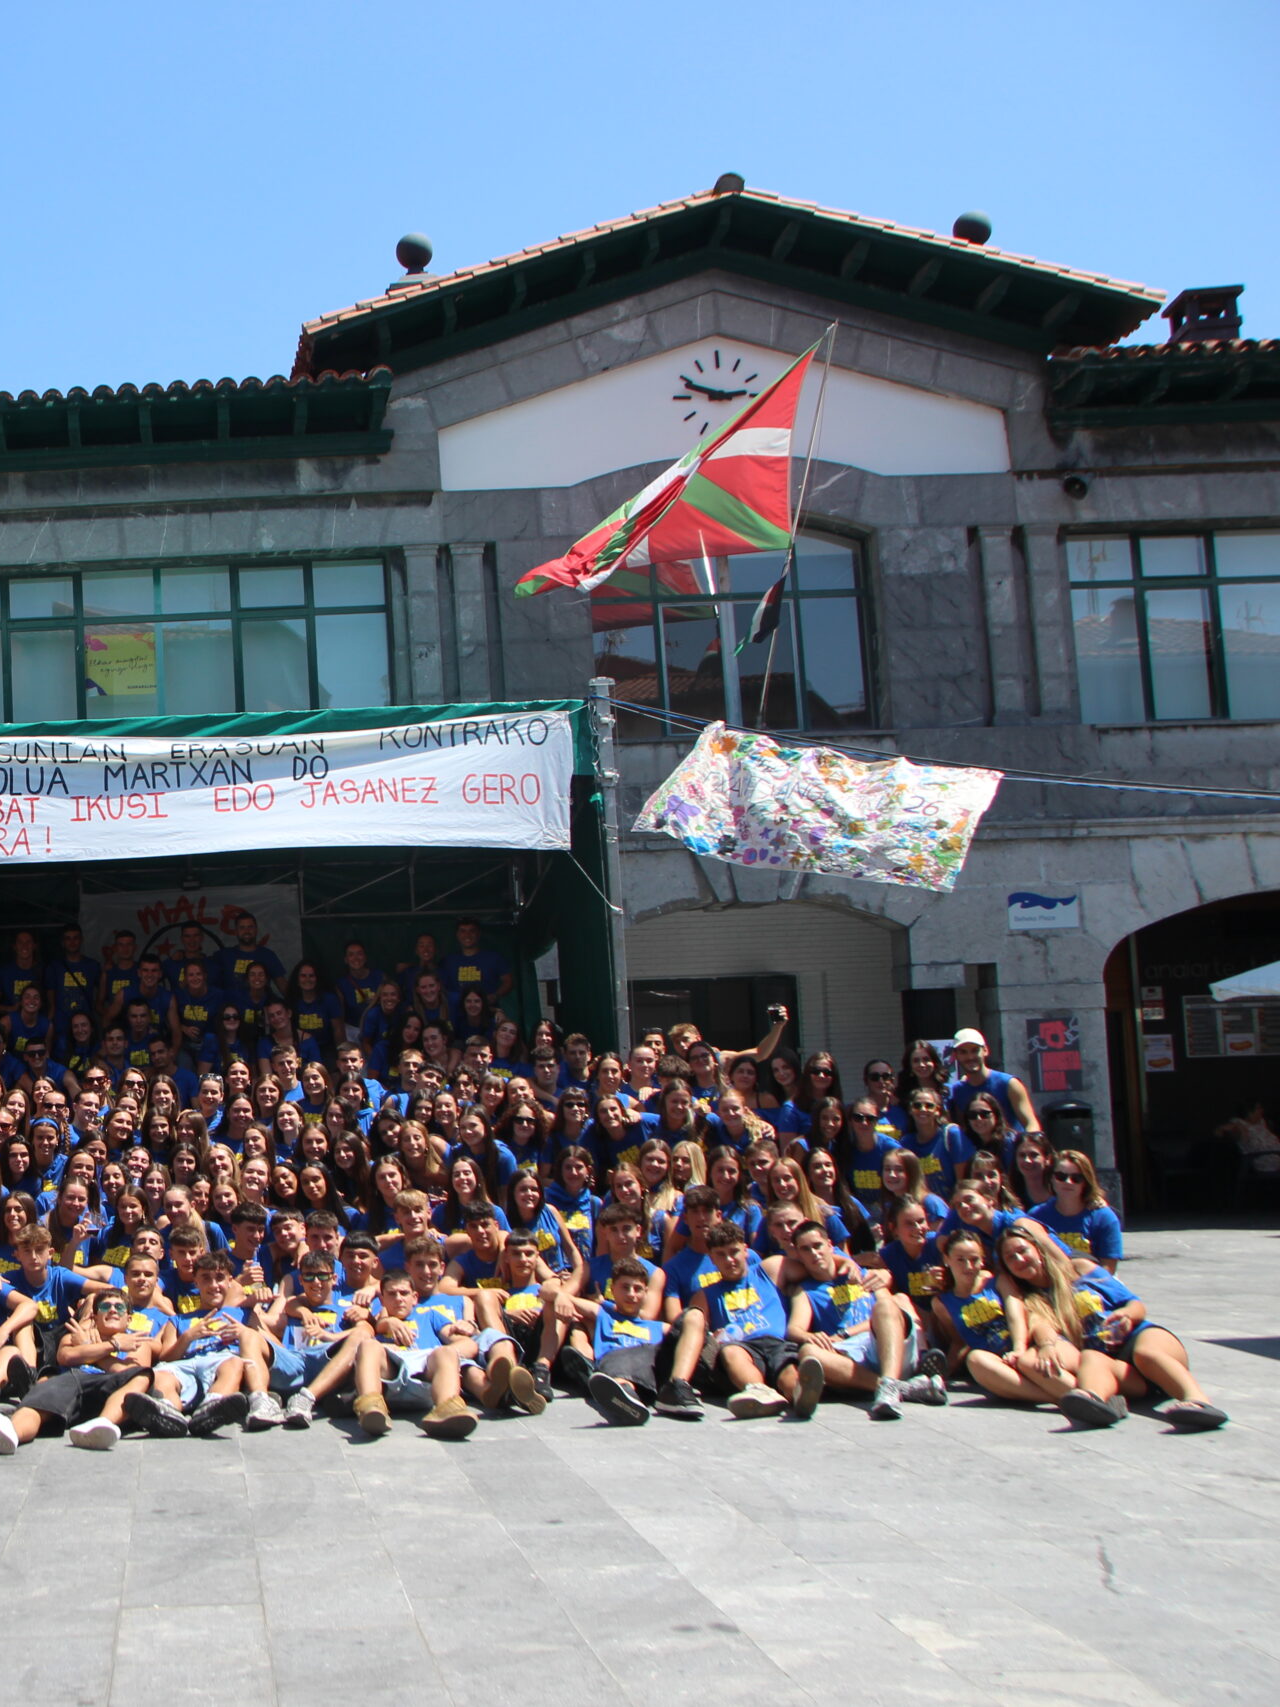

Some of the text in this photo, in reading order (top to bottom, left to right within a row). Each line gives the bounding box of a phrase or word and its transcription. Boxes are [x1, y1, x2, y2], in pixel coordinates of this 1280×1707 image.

[379, 718, 549, 750] KONTRAKO
[104, 759, 253, 791] MARTXAN
[292, 755, 329, 780] DO
[69, 792, 169, 821] IKUSI
[214, 783, 275, 812] EDO
[300, 777, 439, 809] JASANEZ
[461, 773, 541, 805] GERO
